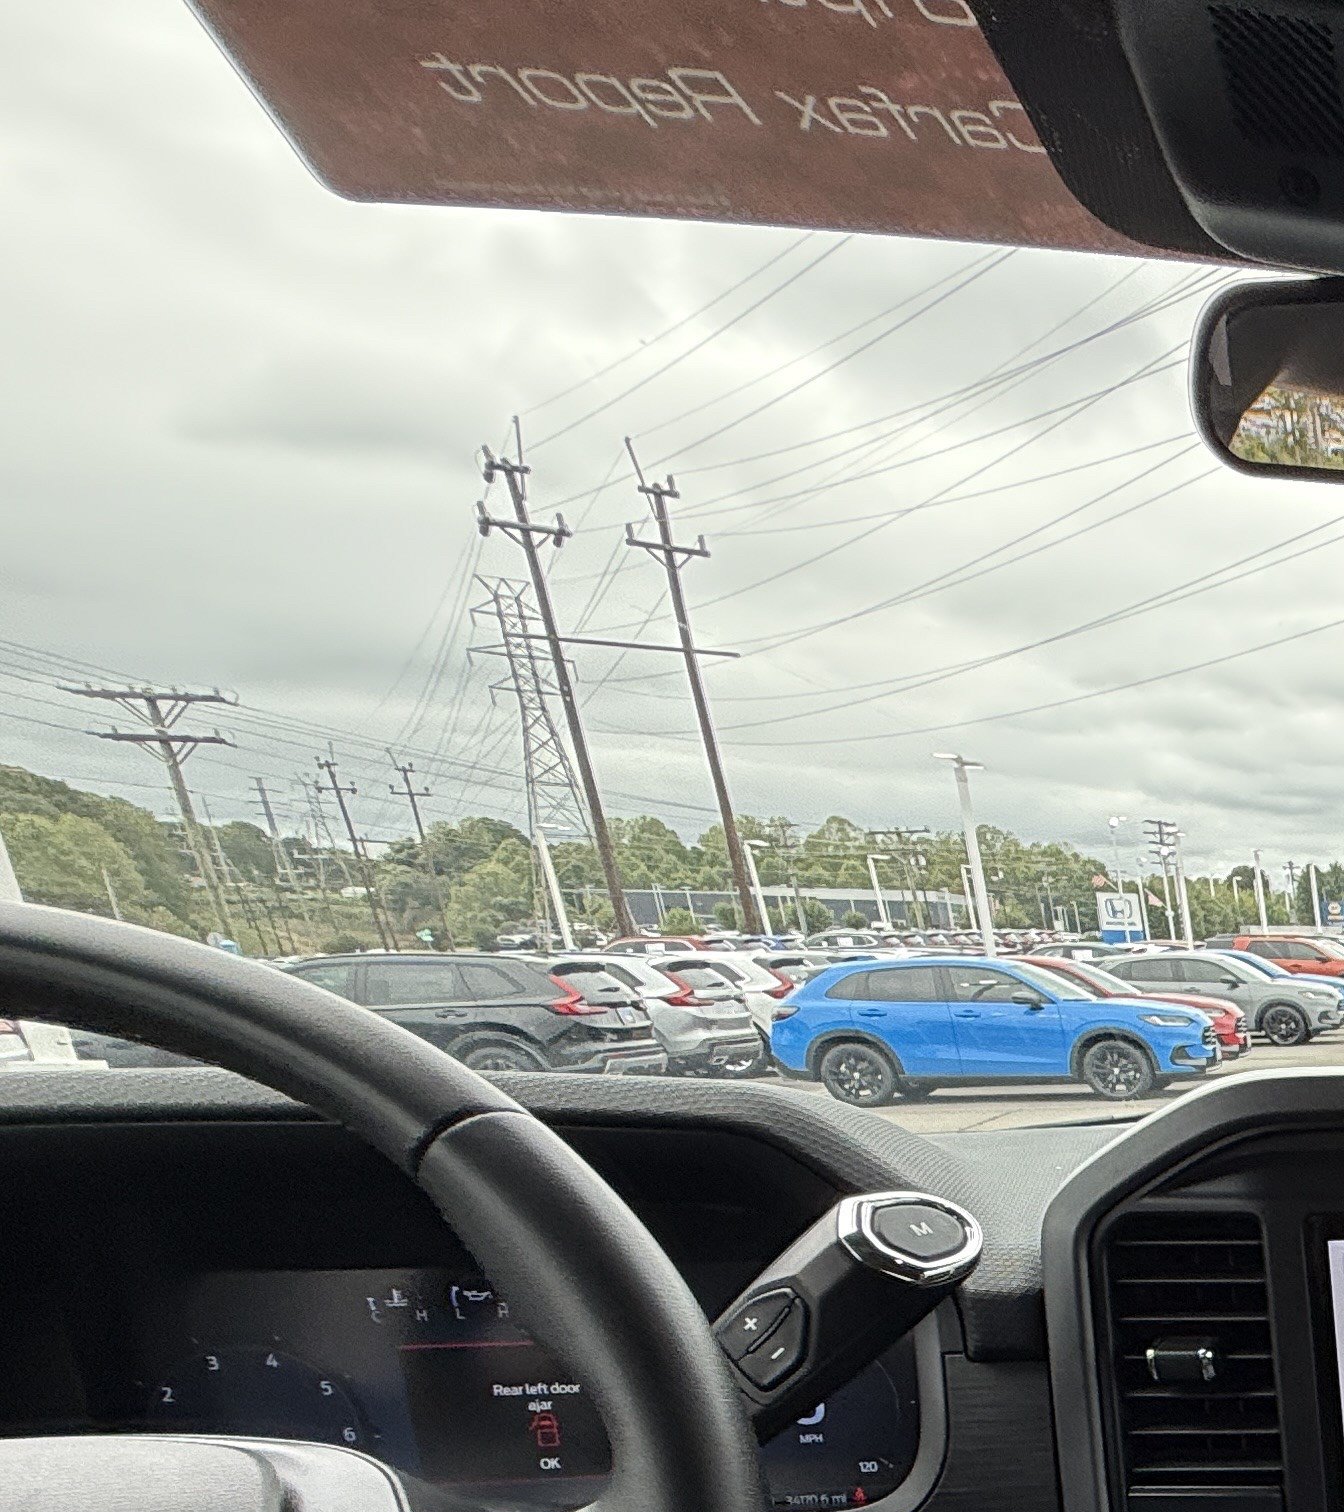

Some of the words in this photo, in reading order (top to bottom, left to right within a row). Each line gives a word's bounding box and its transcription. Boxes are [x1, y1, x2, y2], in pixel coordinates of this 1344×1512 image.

[909, 1221, 933, 1237] M
[206, 1355, 219, 1370] 3
[265, 1353, 279, 1368] 4
[161, 1387, 175, 1402] 2
[320, 1380, 333, 1395] 5
[493, 1384, 524, 1396] Rear
[525, 1383, 549, 1395] left
[550, 1382, 580, 1394] door
[528, 1399, 552, 1412] ajar
[343, 1427, 356, 1441] 6
[799, 1433, 823, 1443] MPH
[540, 1457, 561, 1470] OK
[859, 1461, 878, 1472] 120
